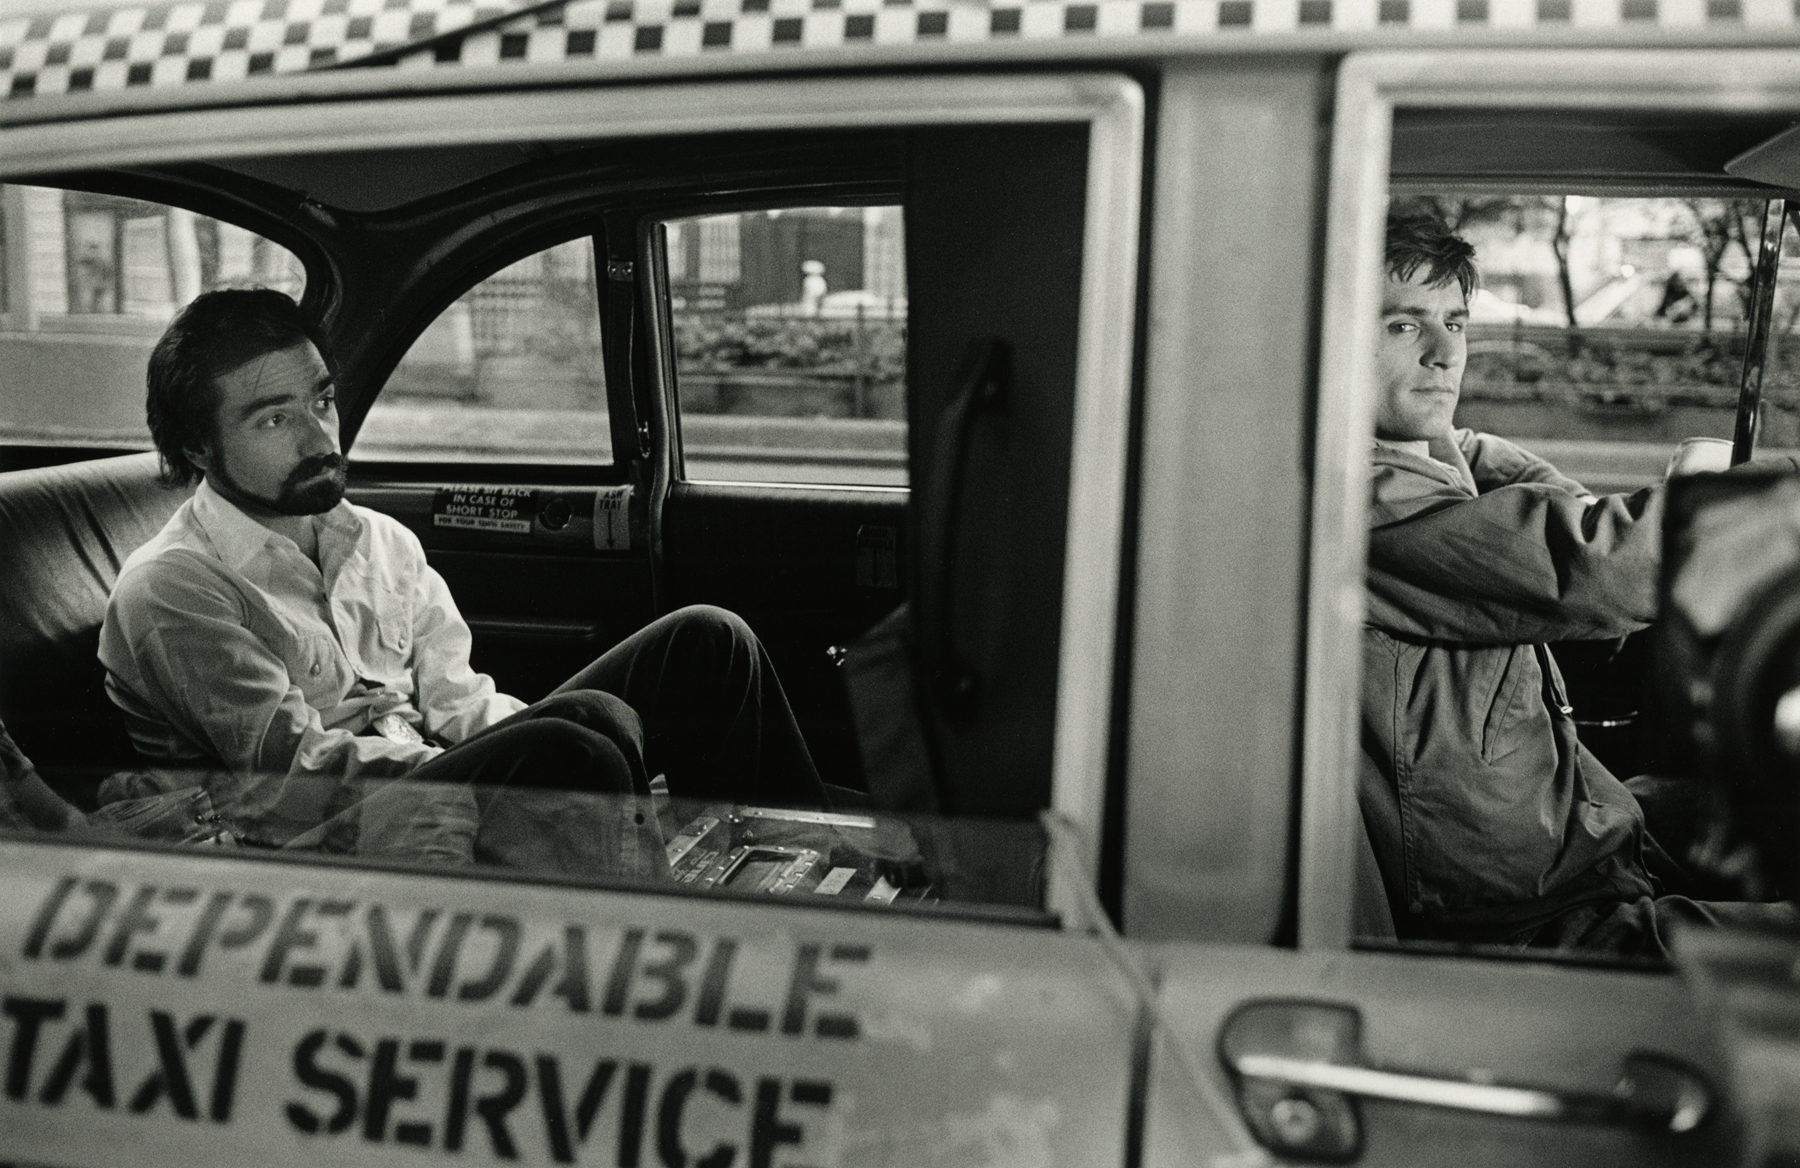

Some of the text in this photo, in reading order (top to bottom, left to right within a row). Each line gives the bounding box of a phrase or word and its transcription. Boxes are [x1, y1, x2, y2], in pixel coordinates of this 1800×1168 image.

[502, 487, 531, 497] BACK
[453, 494, 516, 507] IN CASE OF
[446, 504, 518, 519] SHORT STOP
[501, 521, 526, 529] SAFETY
[23, 875, 871, 1040] DEPENDABLE
[2, 997, 834, 1168] TAXI SERVICE
